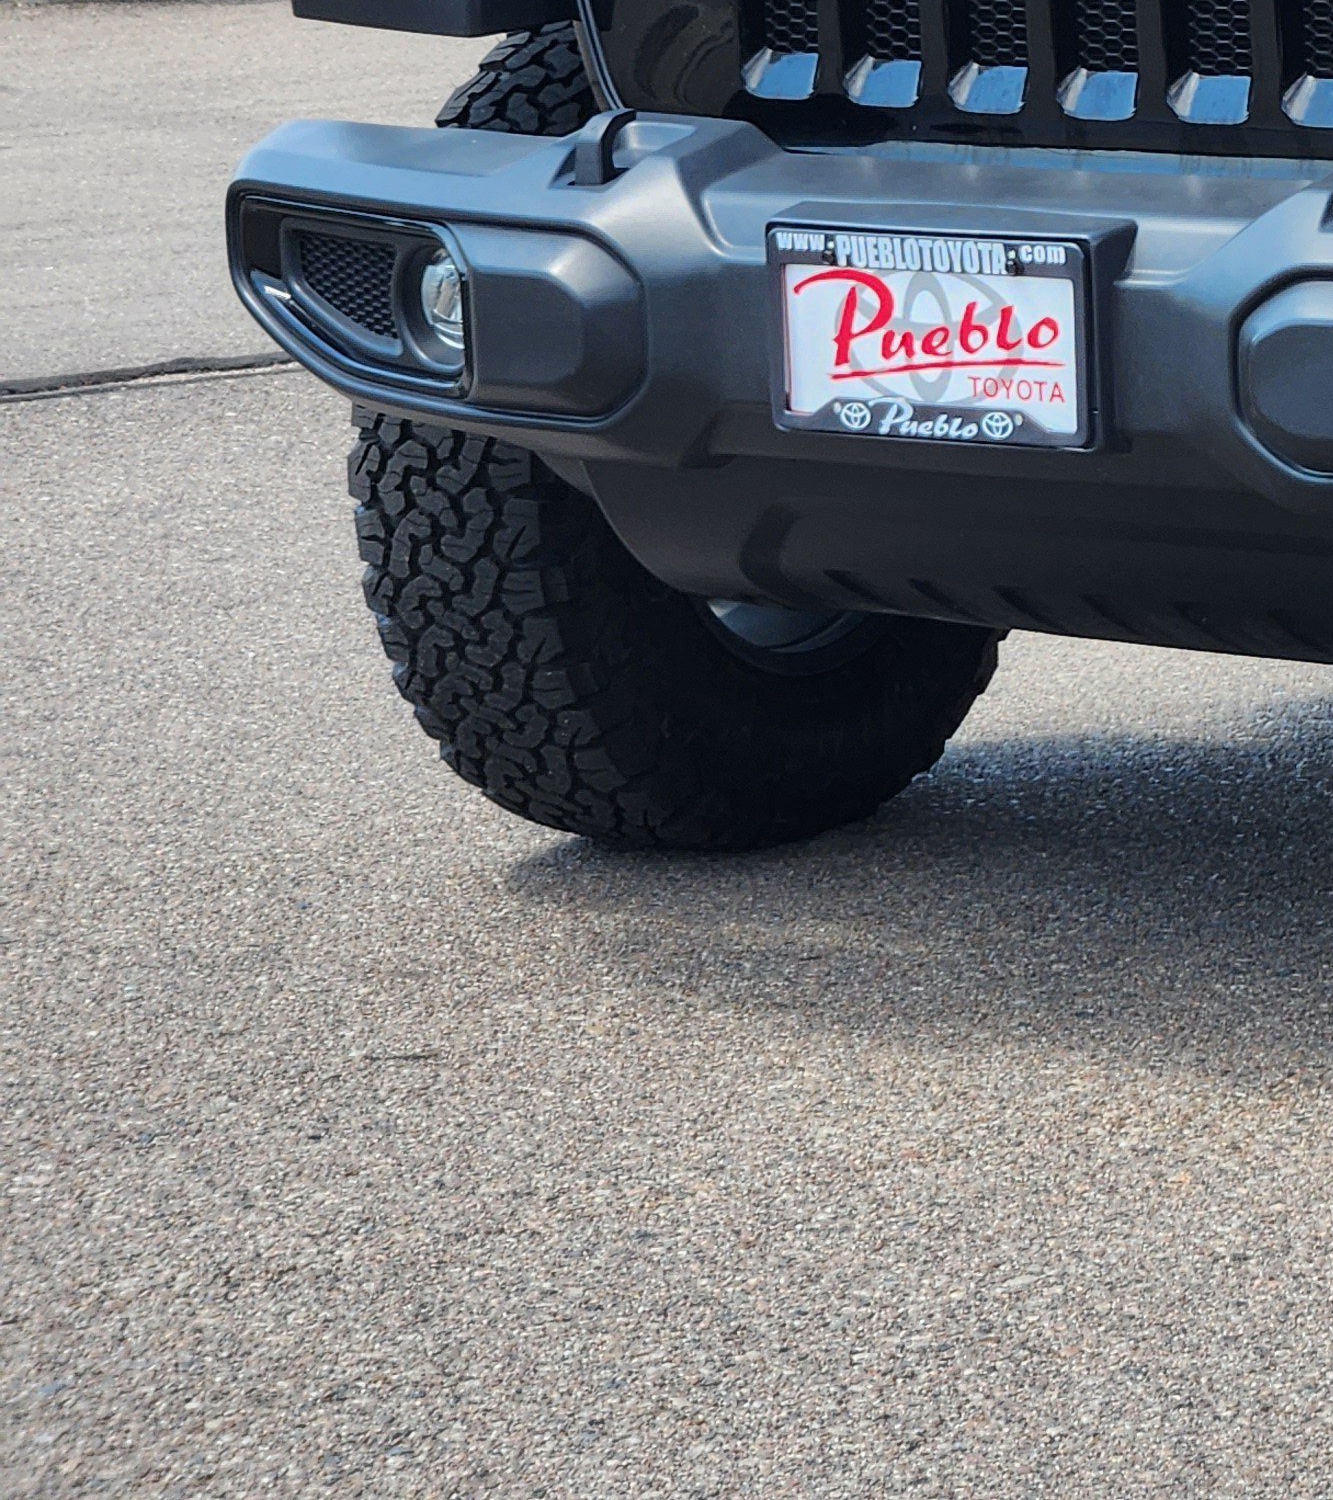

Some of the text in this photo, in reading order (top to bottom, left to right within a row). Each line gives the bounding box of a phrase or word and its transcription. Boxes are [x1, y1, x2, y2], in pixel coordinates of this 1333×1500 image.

[792, 268, 1061, 368] Pueblo
[967, 376, 1067, 404] TOYOTA
[868, 395, 980, 439] Pueblo
